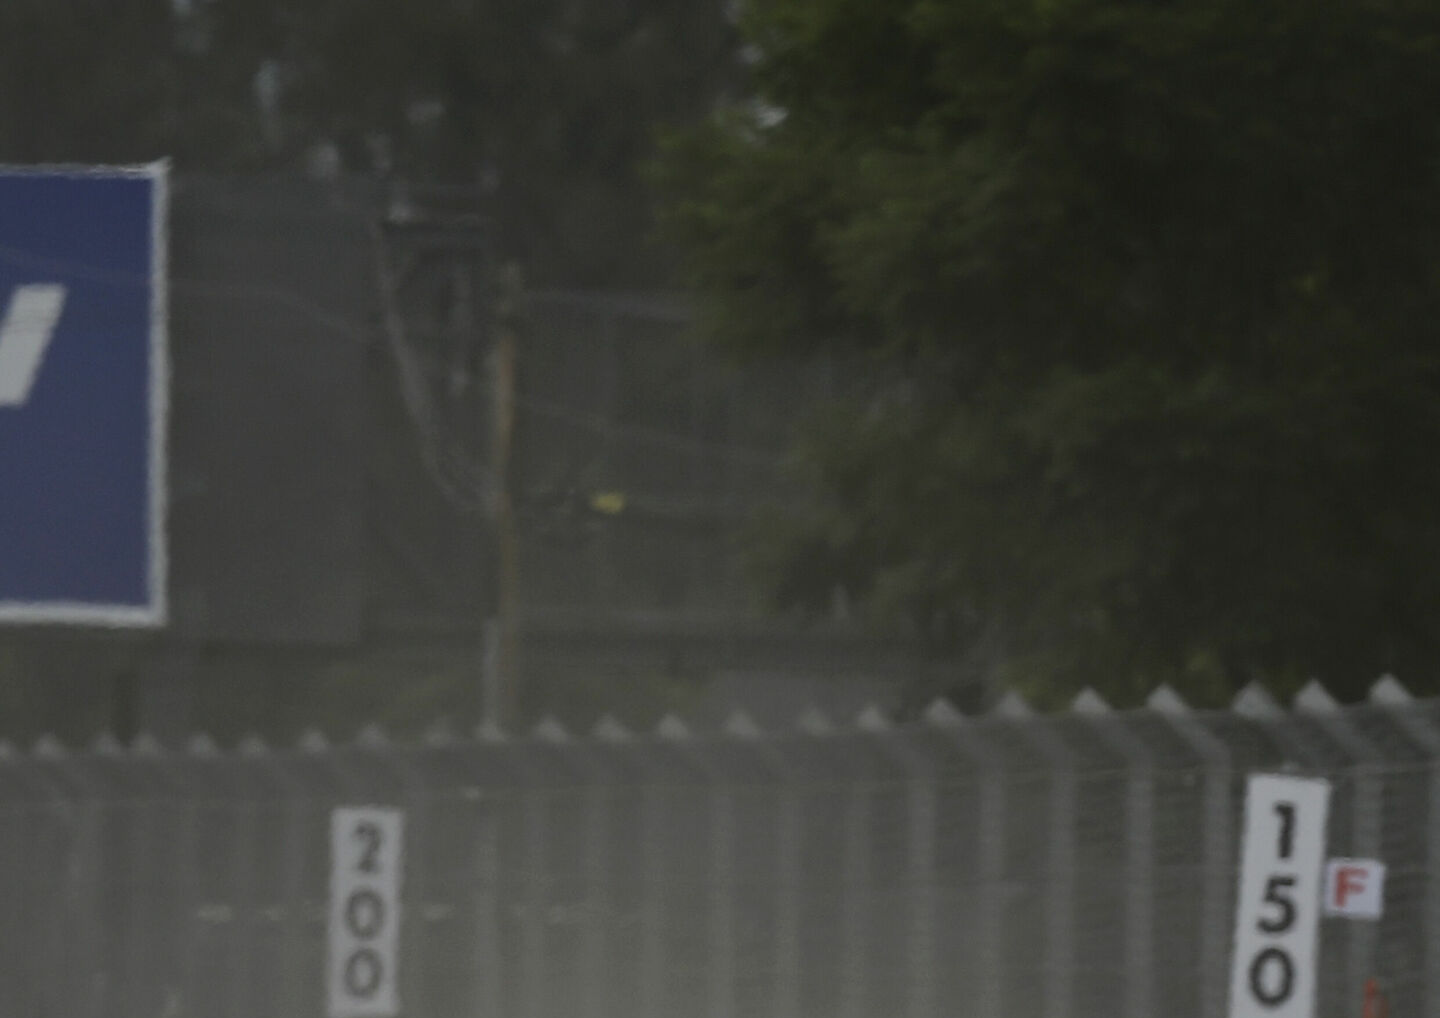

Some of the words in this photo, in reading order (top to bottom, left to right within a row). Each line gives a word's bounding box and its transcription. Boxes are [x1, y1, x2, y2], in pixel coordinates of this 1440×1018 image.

[345, 819, 387, 1000] 200
[1248, 802, 1297, 1010] 150
[1333, 867, 1370, 908] F
